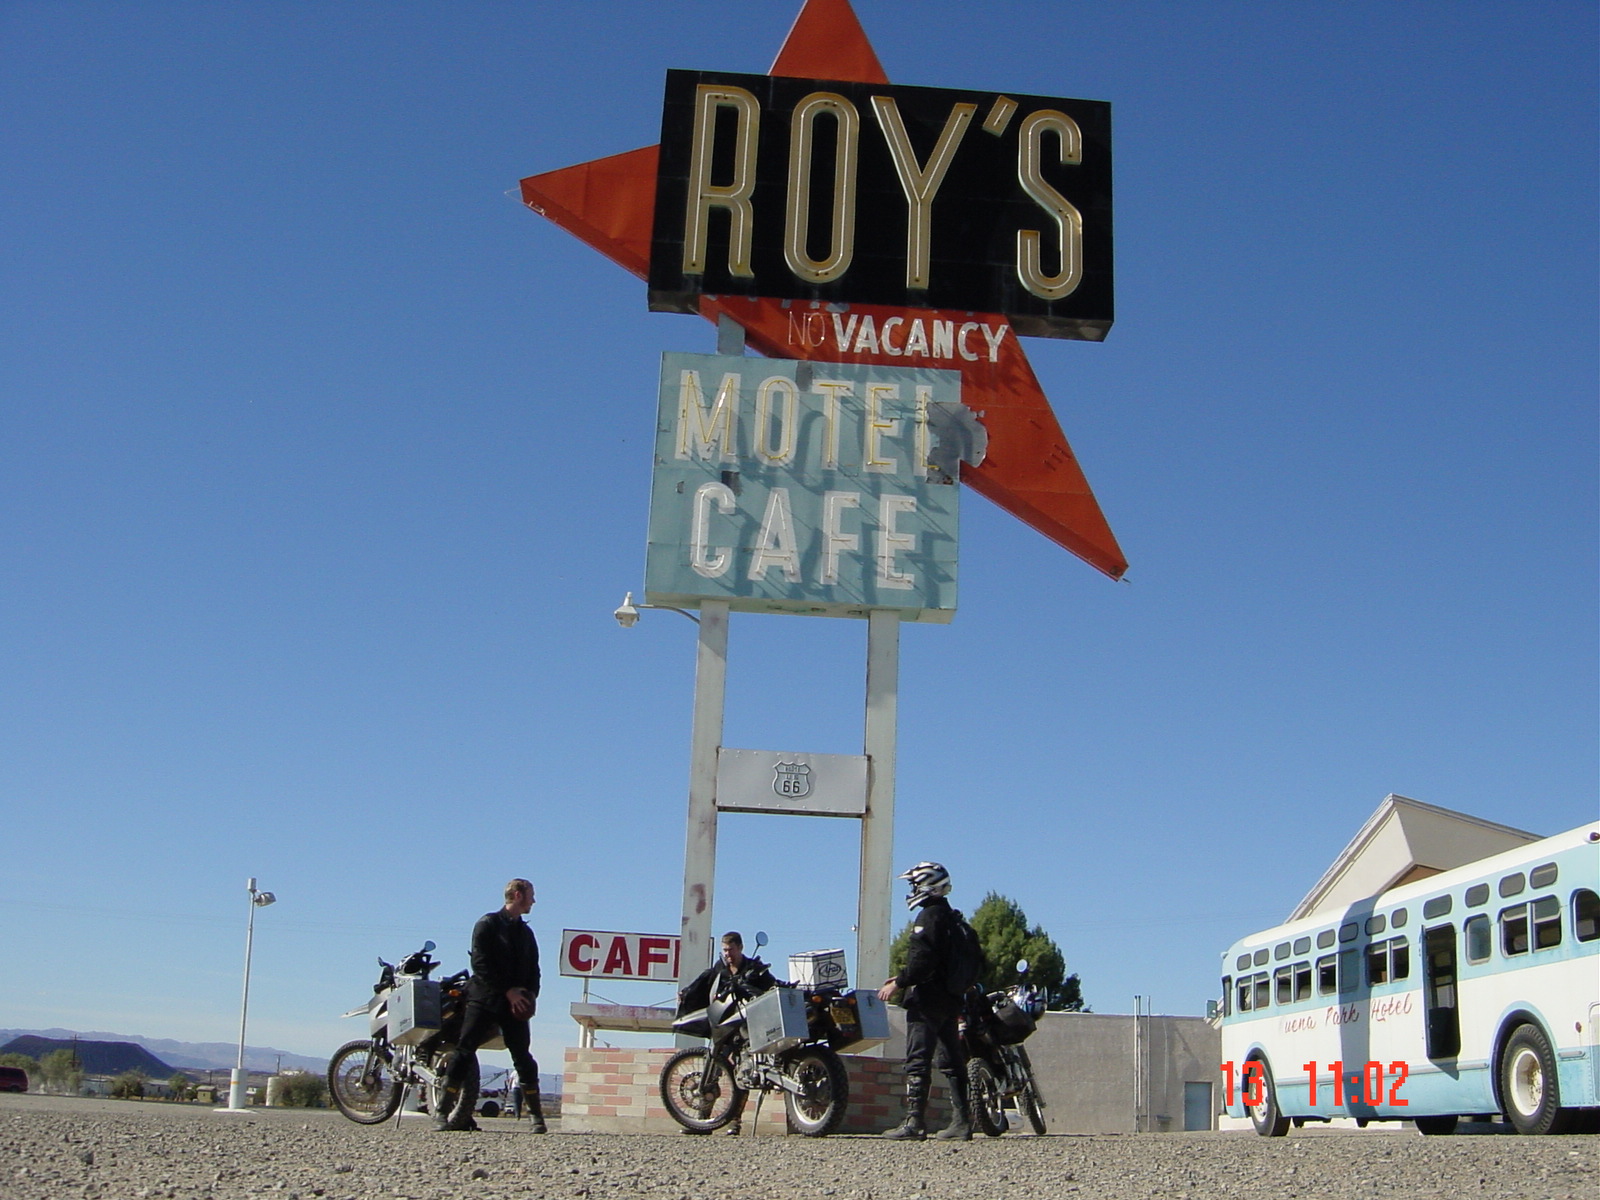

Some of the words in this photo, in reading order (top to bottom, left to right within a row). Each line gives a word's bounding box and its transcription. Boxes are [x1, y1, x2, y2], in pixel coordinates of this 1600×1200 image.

[682, 84, 1083, 300] ROY'S
[788, 311, 826, 346] NO
[832, 312, 1009, 363] VACANCY
[689, 481, 917, 590] CAFE
[782, 780, 800, 794] 66
[1325, 1003, 1360, 1027] Park
[1371, 992, 1412, 1022] Hotel
